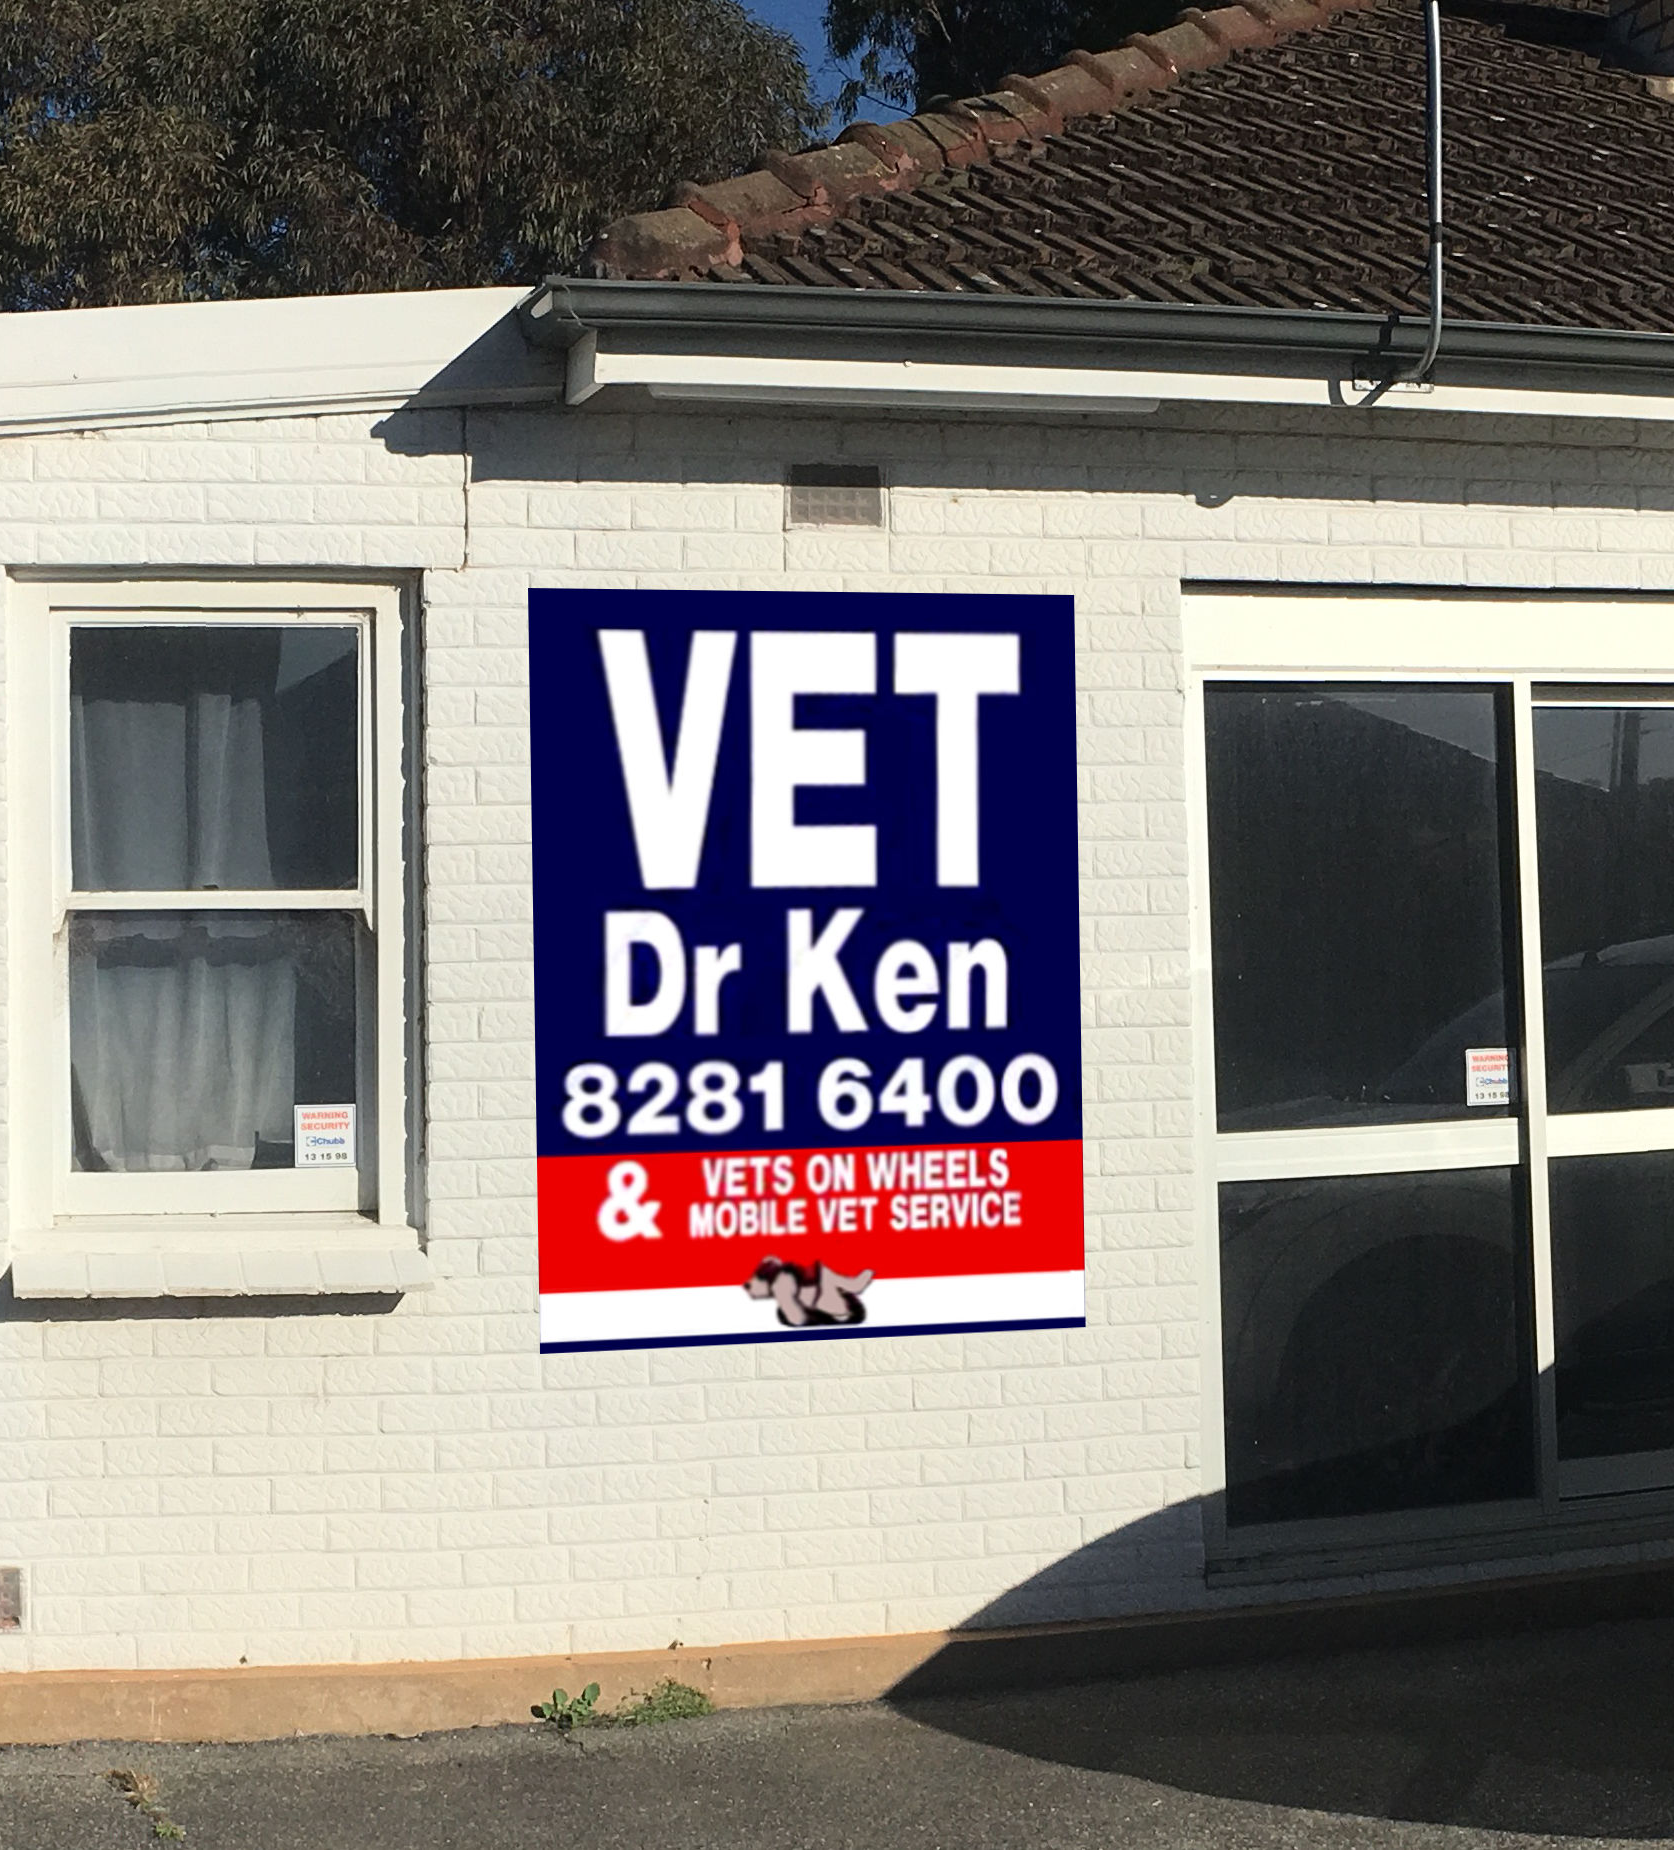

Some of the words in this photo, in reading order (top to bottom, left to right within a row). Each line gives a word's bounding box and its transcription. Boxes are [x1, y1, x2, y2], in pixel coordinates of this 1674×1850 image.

[597, 628, 1022, 889] VET
[603, 909, 743, 1037] Dr
[786, 907, 1009, 1034] Ken
[1472, 1064, 1508, 1072] SECURIT
[302, 1111, 349, 1119] WARNING
[561, 1060, 786, 1139] 8281
[816, 1052, 1059, 1132] 6400
[300, 1121, 350, 1130] SECURITY
[320, 1152, 332, 1160] 15
[702, 1156, 794, 1197] VETS
[806, 1153, 855, 1192] ON
[866, 1148, 1010, 1190] WHEELS
[597, 1160, 663, 1242] &
[689, 1199, 807, 1238] MOBILE
[816, 1197, 878, 1233] VET
[888, 1191, 1022, 1231] SERVICE
